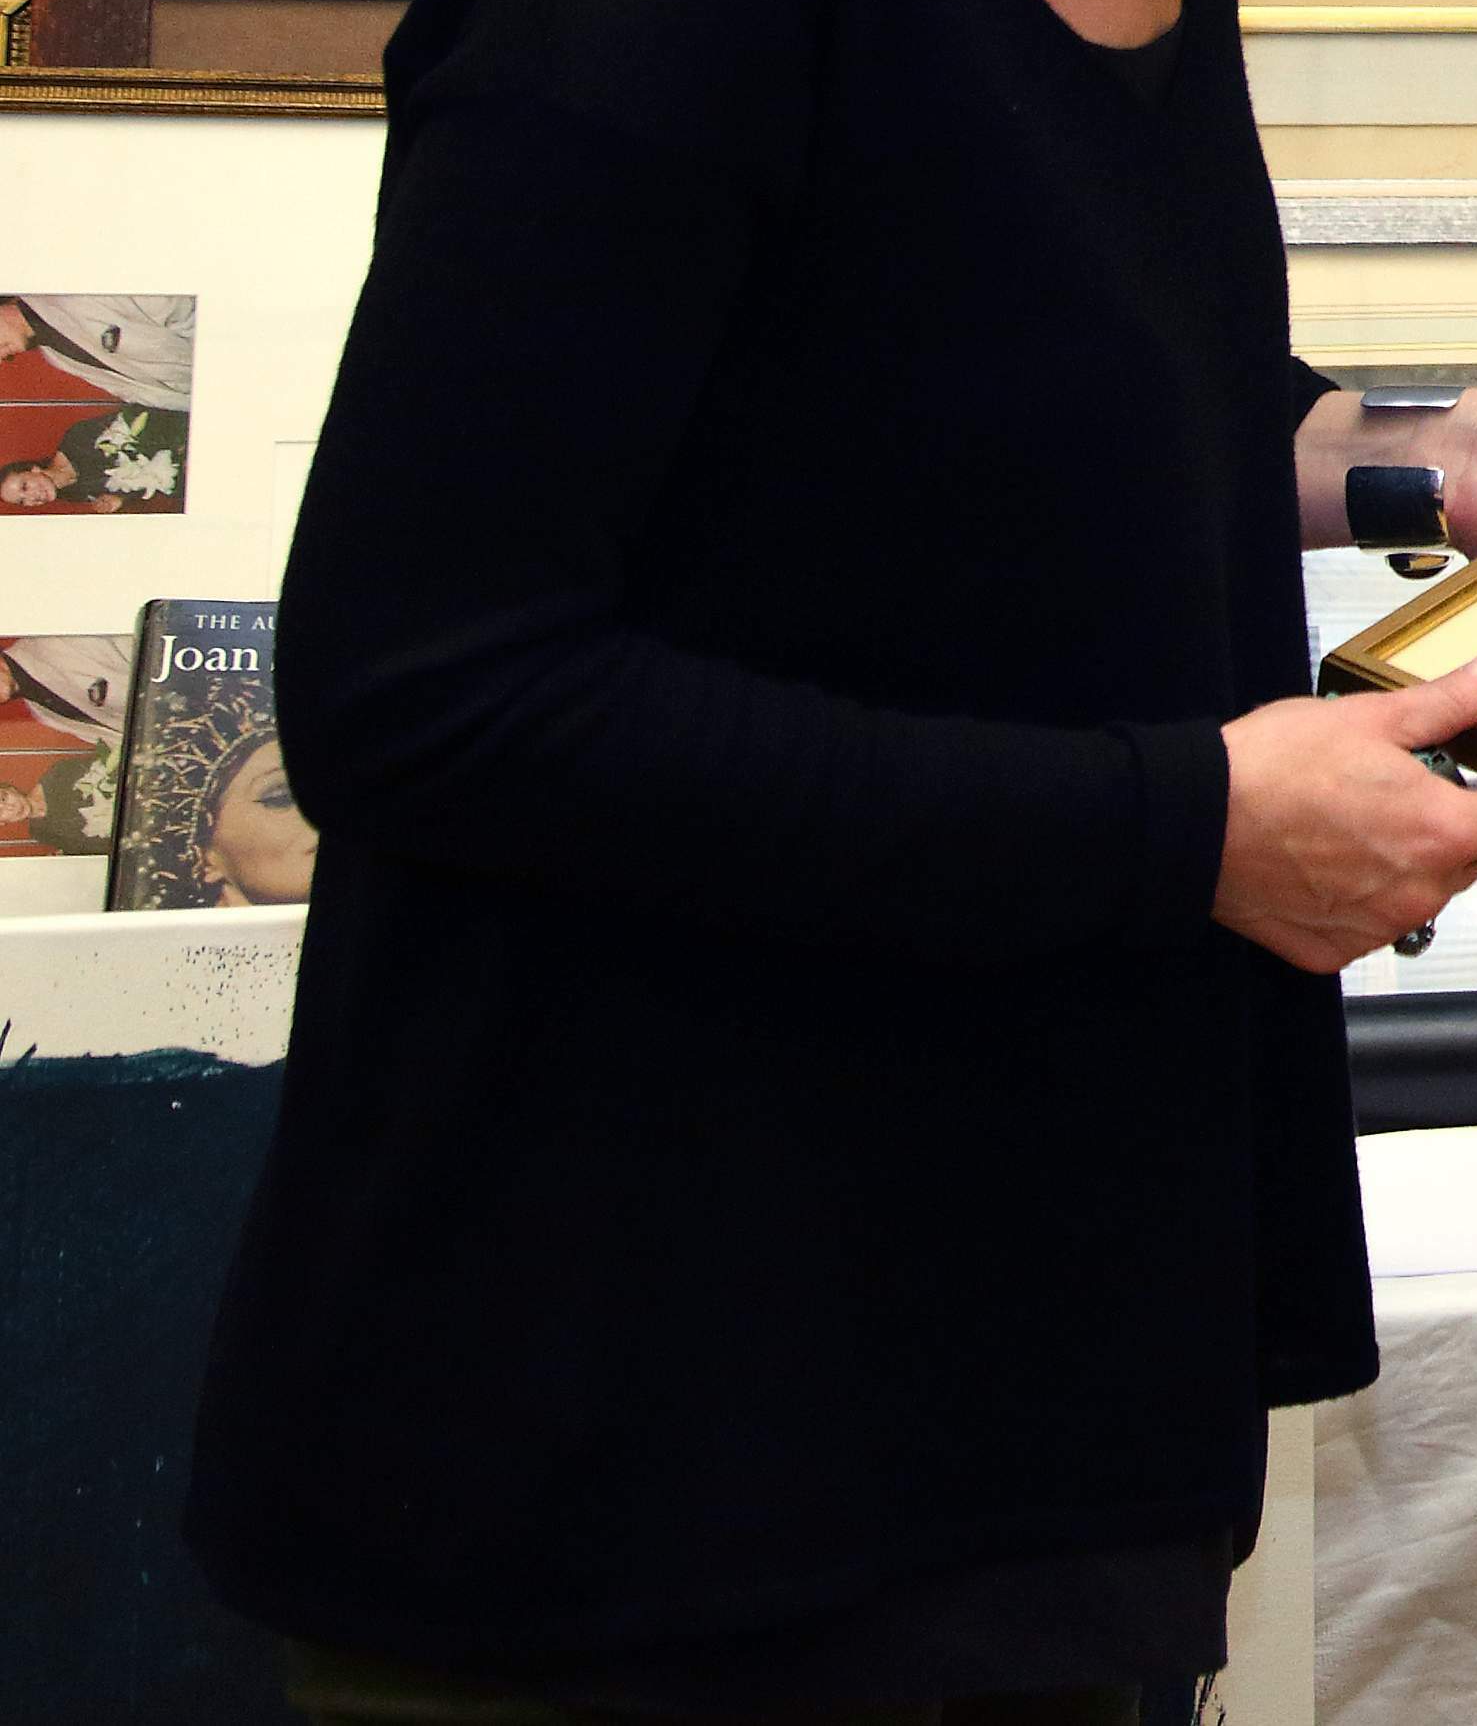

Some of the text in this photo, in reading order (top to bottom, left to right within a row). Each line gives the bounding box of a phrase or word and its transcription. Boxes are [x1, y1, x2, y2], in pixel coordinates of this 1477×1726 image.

[195, 614, 276, 631] THE AU
[151, 635, 260, 683] Joan
